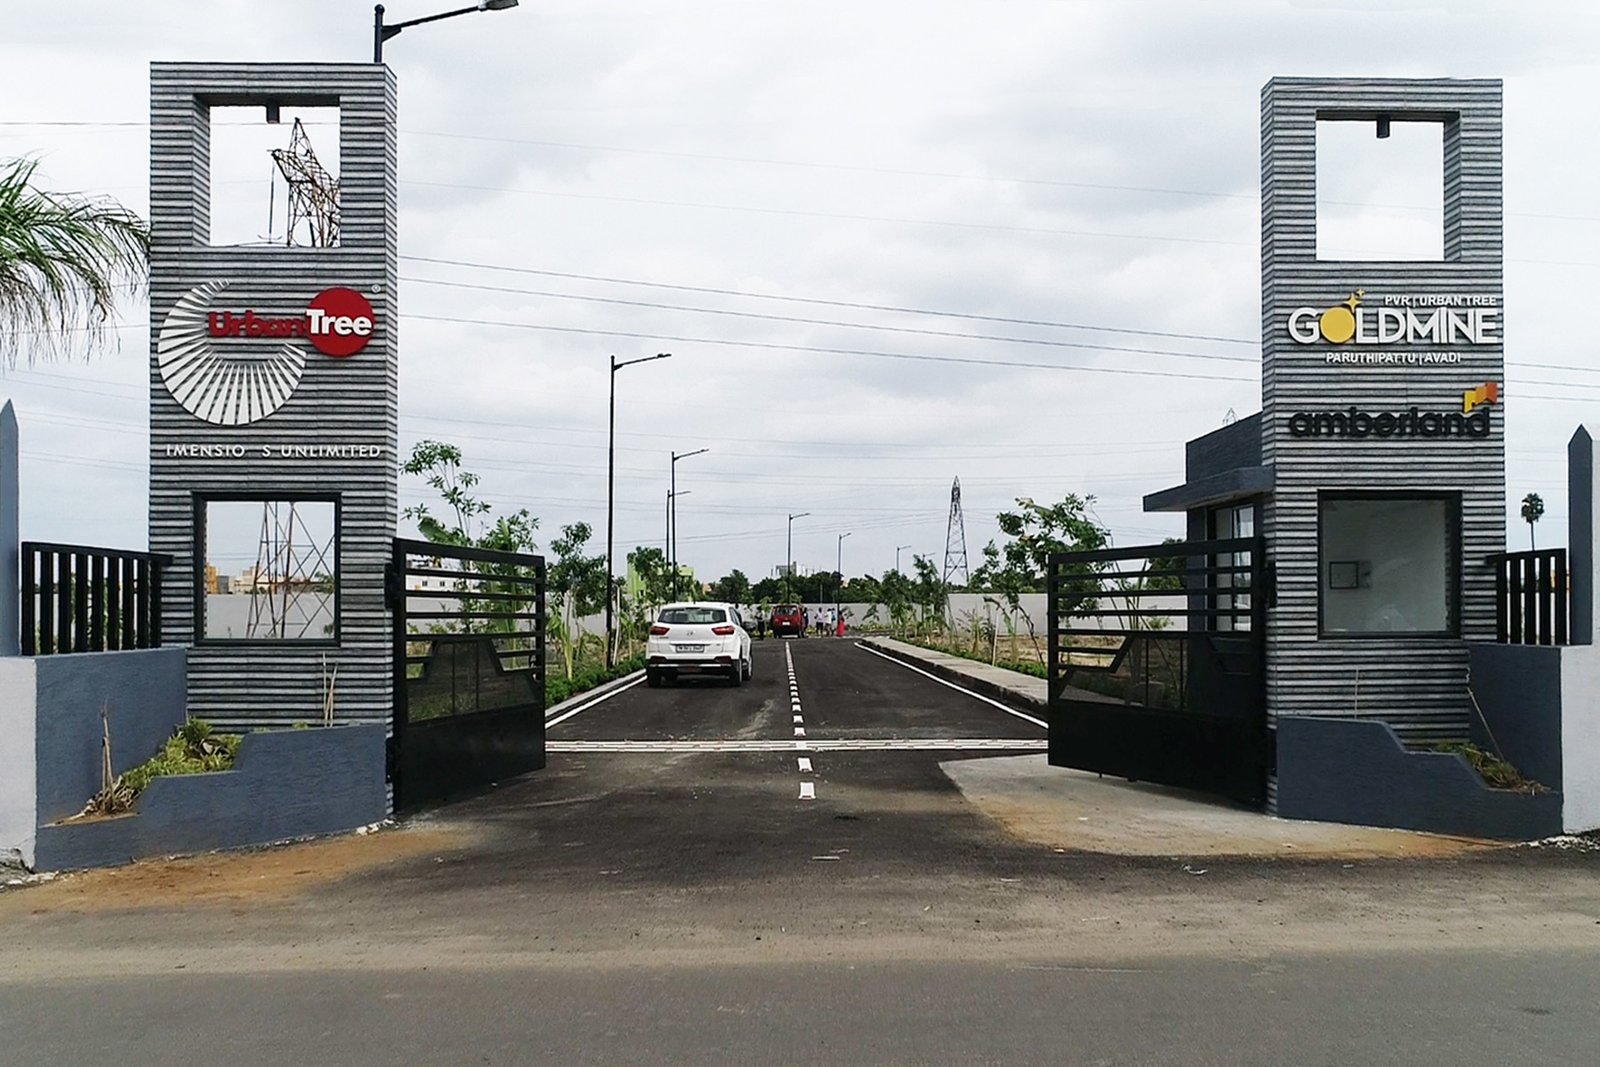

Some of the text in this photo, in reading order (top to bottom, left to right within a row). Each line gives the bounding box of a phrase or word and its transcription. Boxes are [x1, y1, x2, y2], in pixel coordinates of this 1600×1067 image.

[1384, 294, 1410, 306] PVR
[1419, 294, 1461, 306] URBAN
[1463, 294, 1497, 306] TREE
[1288, 307, 1498, 344] GOLDMINE
[1325, 352, 1416, 364] PARUTHIPATTU
[1424, 352, 1461, 364] AVADI
[1289, 407, 1490, 438] amberland
[281, 444, 381, 458] UNLIMITED
